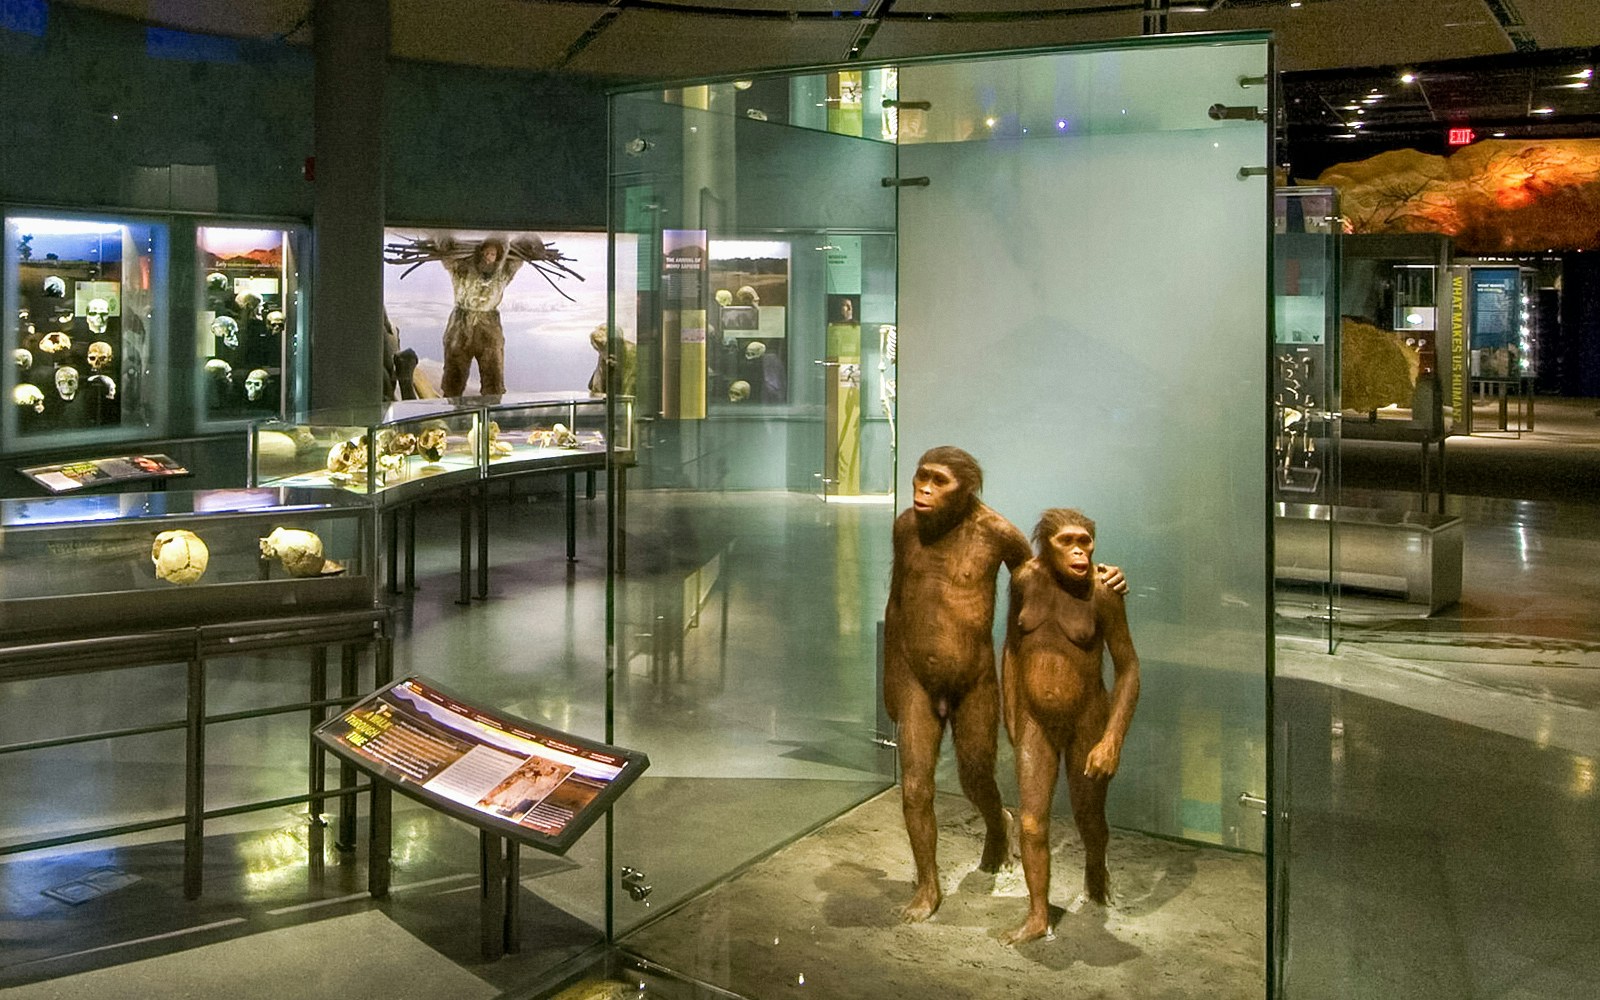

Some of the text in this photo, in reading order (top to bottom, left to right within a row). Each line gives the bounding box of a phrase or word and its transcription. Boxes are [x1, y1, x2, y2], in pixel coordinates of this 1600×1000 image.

[1449, 129, 1471, 144] EXIT
[1452, 276, 1463, 424] WHAT MAKES US HUMAN?
[345, 714, 381, 738] THROUGH
[346, 731, 368, 747] TIME
